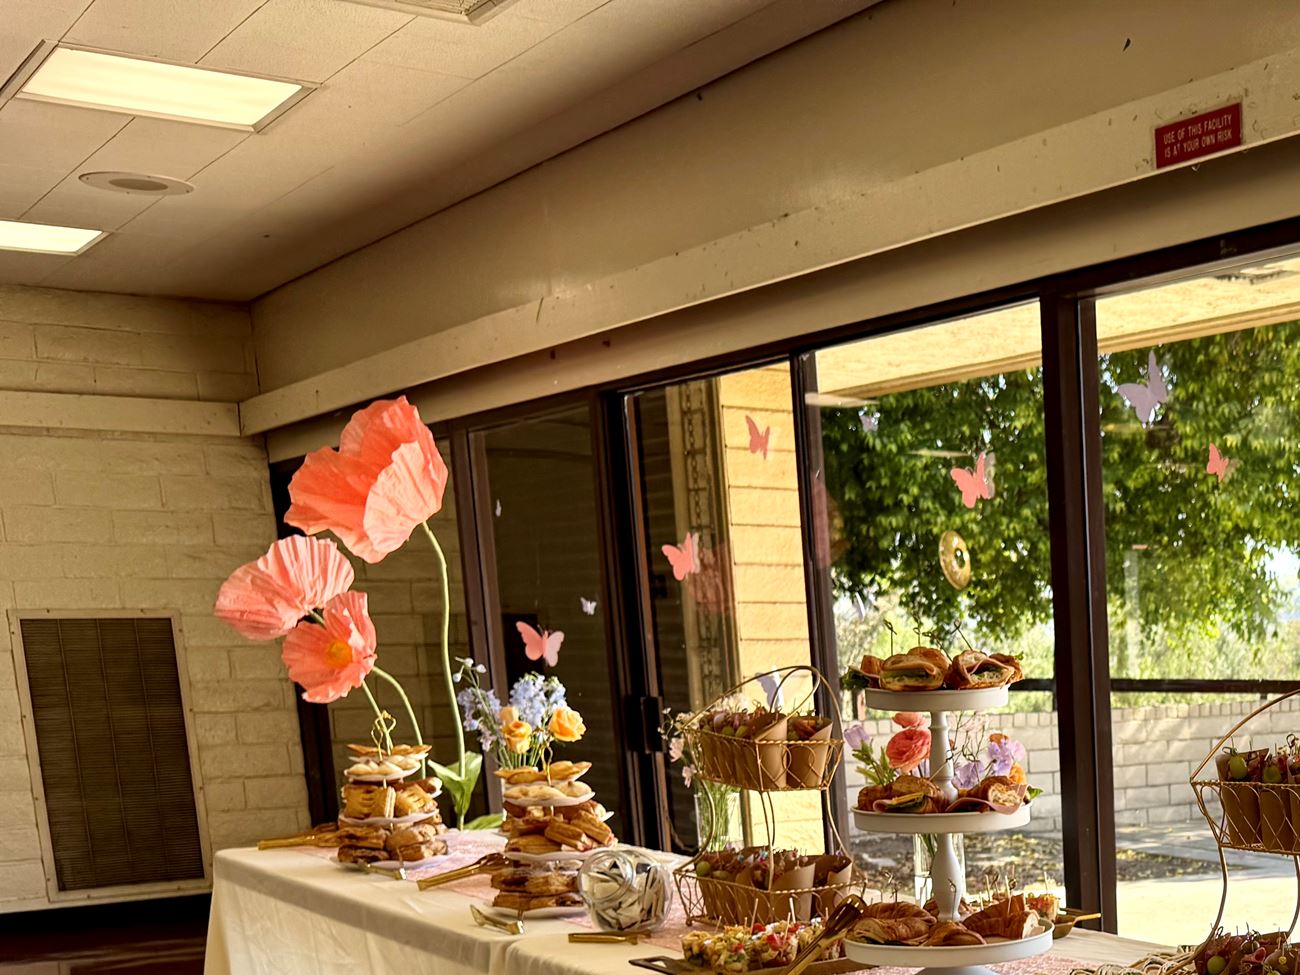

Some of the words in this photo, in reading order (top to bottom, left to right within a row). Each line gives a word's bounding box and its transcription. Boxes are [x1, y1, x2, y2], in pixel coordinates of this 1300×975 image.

[1163, 131, 1175, 145] USE
[1177, 128, 1186, 140] OF
[1188, 123, 1202, 137] THIS
[1204, 114, 1232, 133] FACILITY
[1164, 147, 1171, 158] IS
[1173, 143, 1181, 157] AT
[1183, 138, 1200, 152] YOUR
[1201, 133, 1216, 147] OWN
[1217, 129, 1232, 142] RISK
